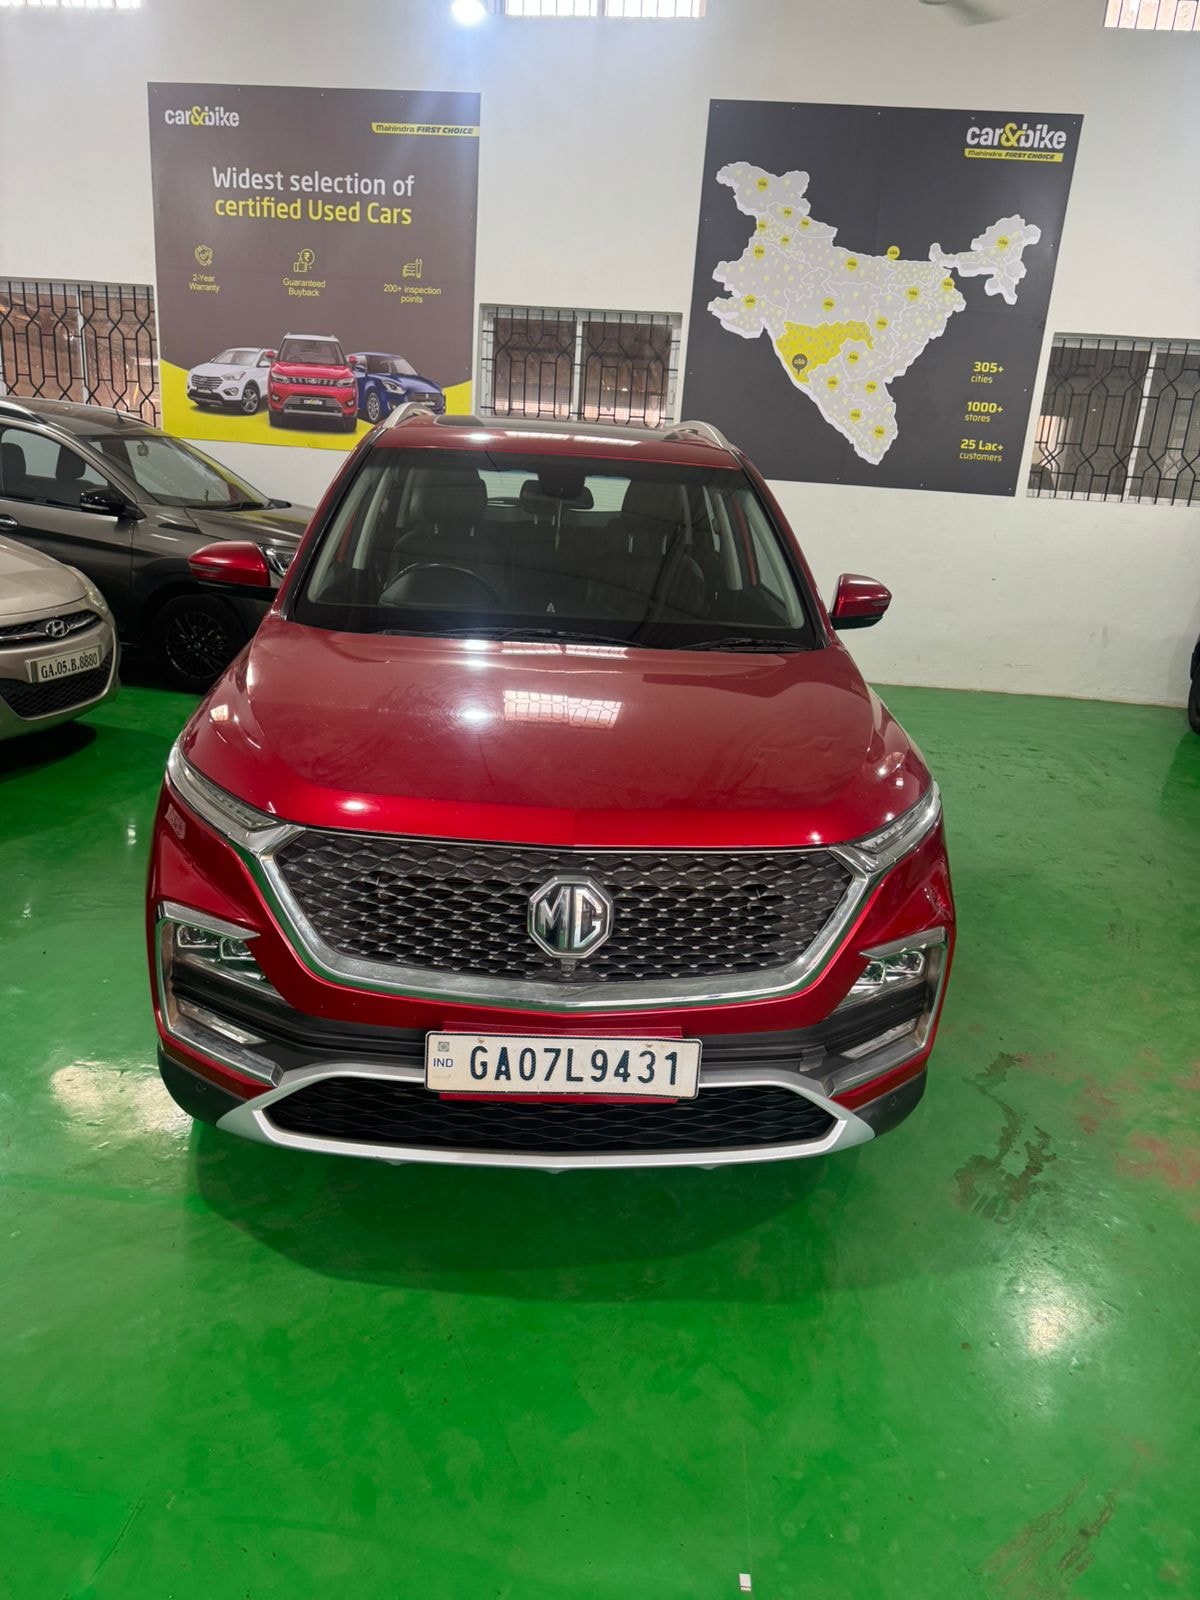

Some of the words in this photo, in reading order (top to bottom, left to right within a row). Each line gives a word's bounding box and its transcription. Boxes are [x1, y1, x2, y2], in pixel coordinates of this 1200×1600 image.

[165, 106, 240, 127] car&bike
[376, 124, 415, 132] Mahindra
[416, 126, 442, 134] FIRST
[442, 127, 474, 135] CHOICE
[966, 122, 1067, 149] car&bike
[212, 167, 283, 191] Widest
[290, 171, 386, 195] selection
[393, 175, 415, 197] of
[214, 197, 301, 220] certified
[308, 200, 360, 223] Used
[367, 203, 412, 225] Cars
[192, 274, 215, 282] 2-Year
[282, 278, 326, 288] Guaranteed
[188, 282, 220, 293] Warranty
[288, 287, 320, 298] Buyback
[383, 284, 402, 293] 200+
[404, 285, 442, 296] inspection
[400, 295, 423, 304] points
[973, 361, 1004, 373] 305+
[970, 374, 993, 384] cities
[967, 401, 1004, 413] 1000+
[964, 413, 991, 423] stores
[960, 439, 976, 449] 25
[978, 440, 1004, 452] Lac+
[959, 452, 1003, 462] customers
[539, 885, 605, 949] MG
[433, 1058, 454, 1068] IND
[470, 1045, 679, 1086] GA07L9431
